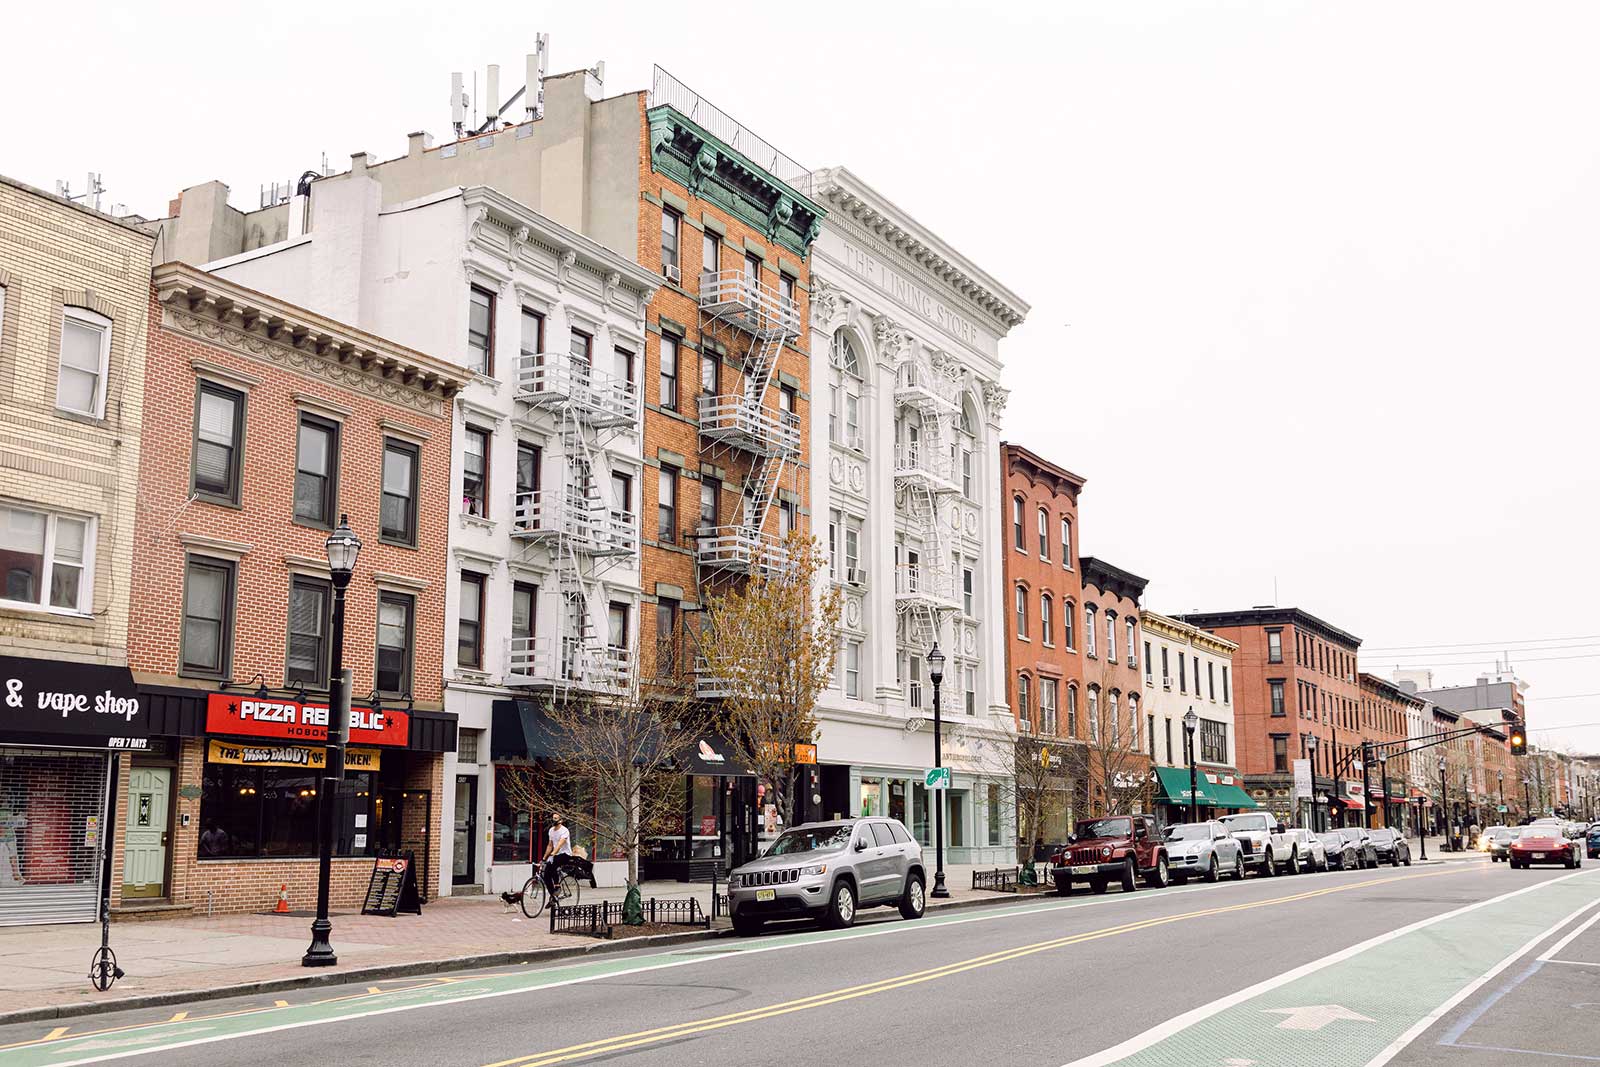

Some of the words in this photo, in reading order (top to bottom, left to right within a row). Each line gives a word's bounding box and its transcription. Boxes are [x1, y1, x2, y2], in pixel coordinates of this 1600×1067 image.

[843, 242, 875, 280] THE
[937, 303, 977, 344] STORE
[5, 678, 24, 708] &
[38, 691, 91, 718] vape
[94, 689, 140, 722] shop
[240, 700, 296, 724] PIZZA
[301, 706, 384, 730] REBLIC
[287, 726, 326, 737] HOBOK
[108, 737, 125, 748] OPEN
[125, 738, 131, 748] 7
[130, 738, 147, 749] DAYS
[220, 746, 240, 760] THE
[311, 752, 324, 764] OF
[345, 753, 372, 766] OKEN!
[942, 768, 948, 778] 2
